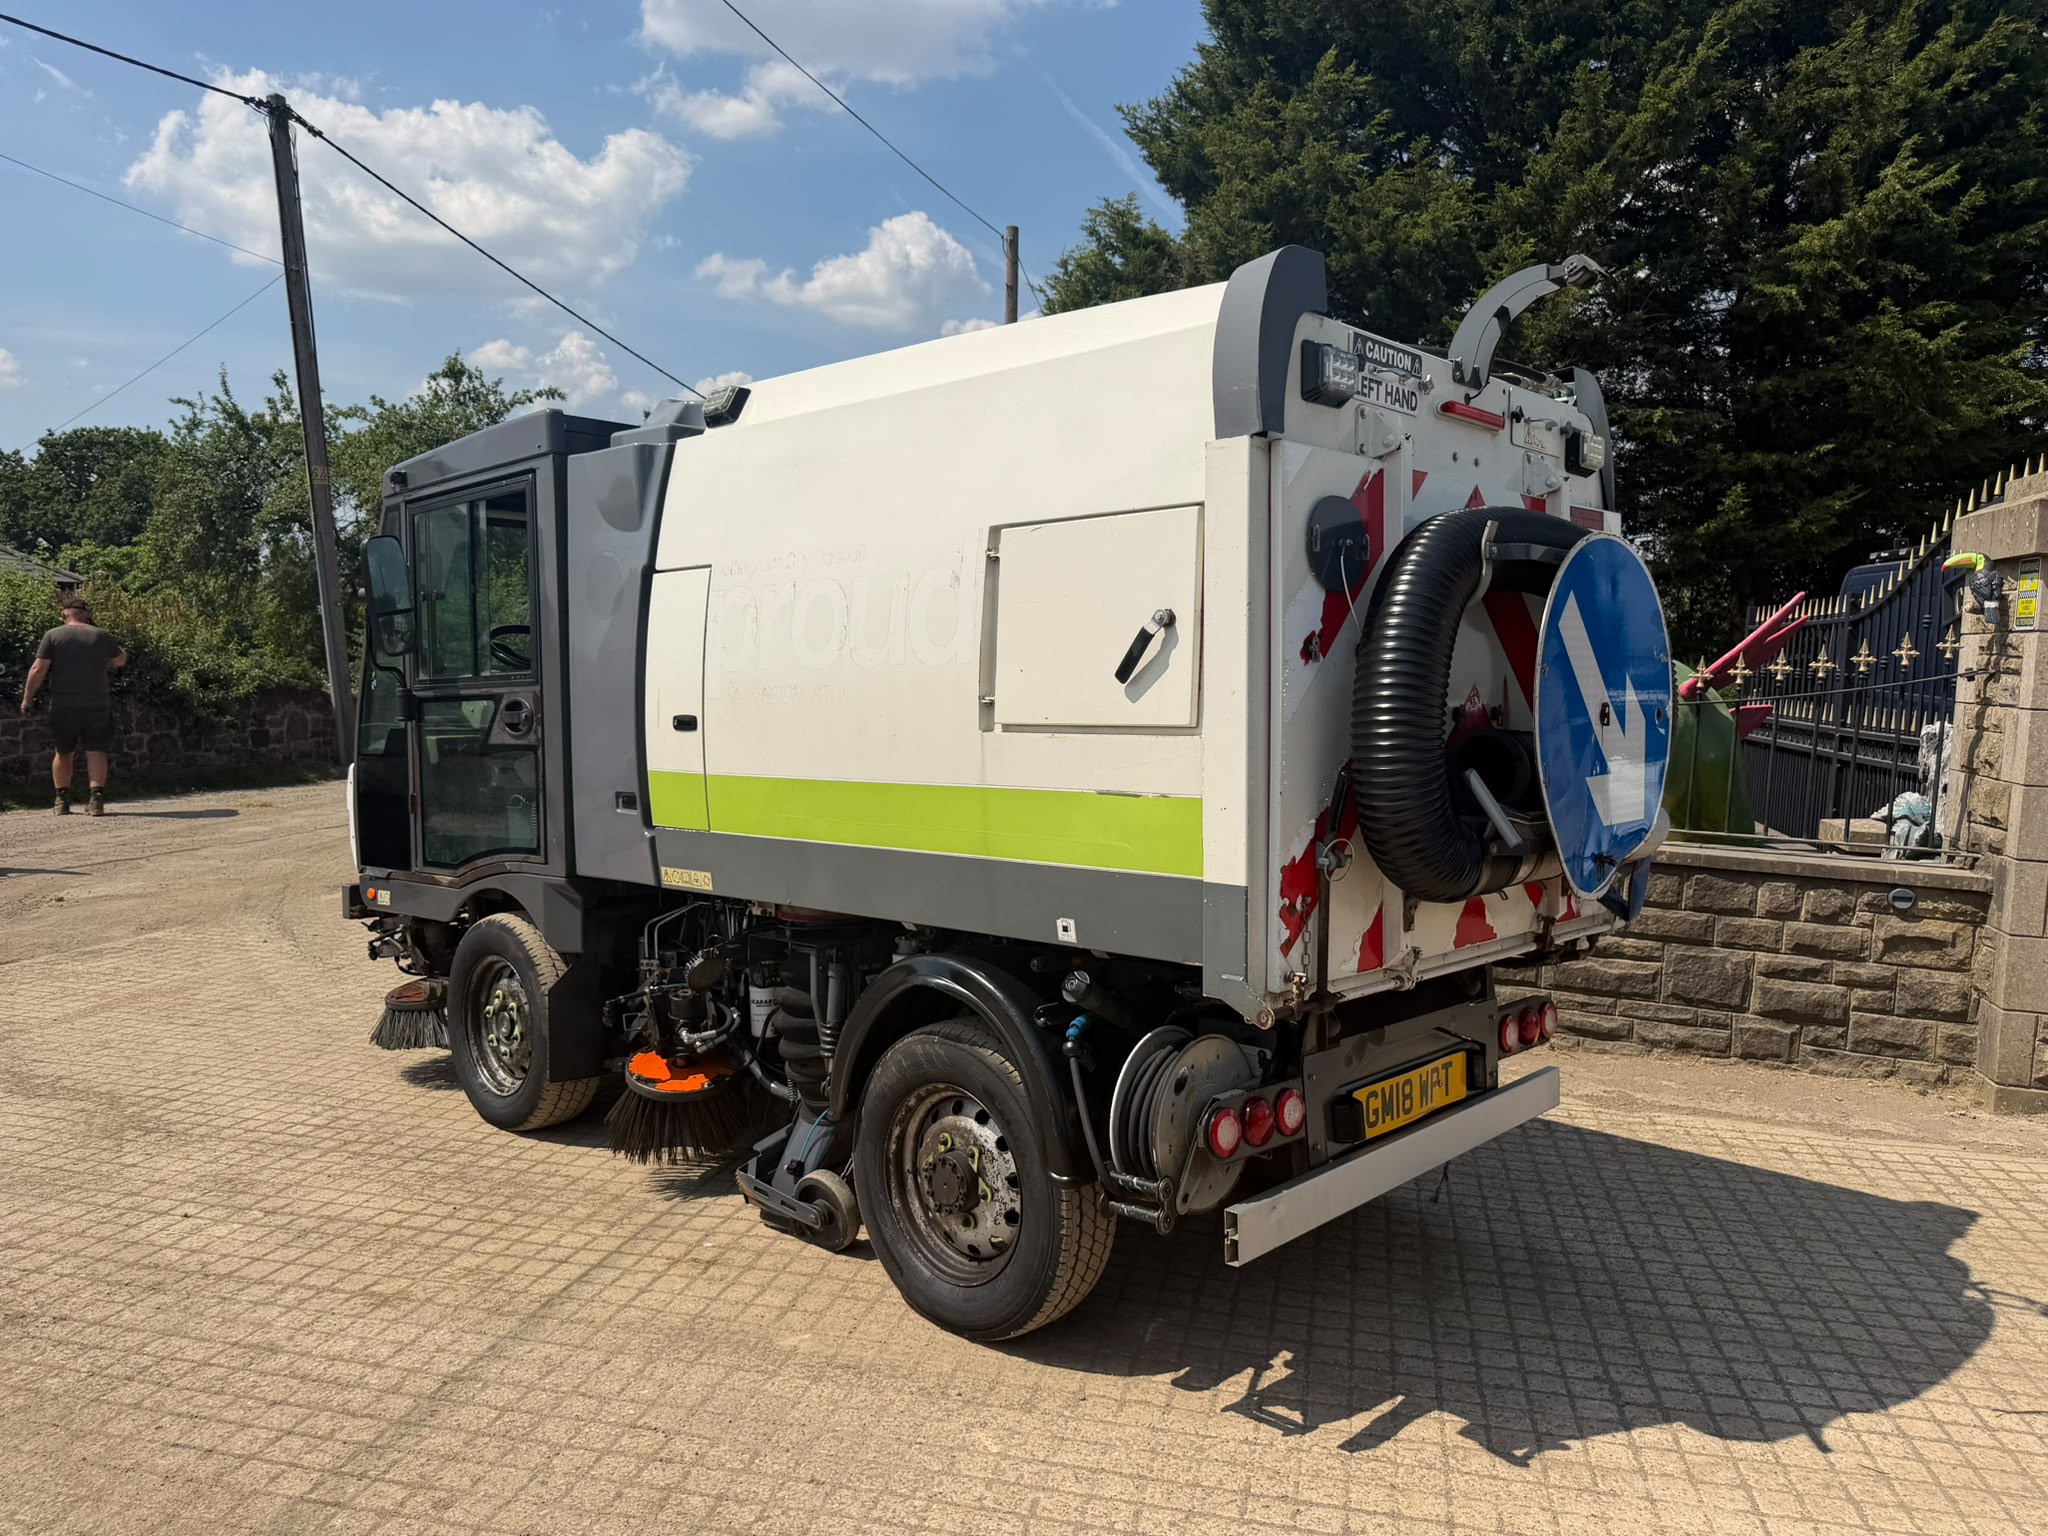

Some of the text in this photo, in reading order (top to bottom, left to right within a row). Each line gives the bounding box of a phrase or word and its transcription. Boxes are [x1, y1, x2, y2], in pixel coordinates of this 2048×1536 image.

[1365, 341, 1412, 371] CAUTION
[1355, 375, 1418, 412] EFT HAND
[1365, 1060, 1454, 1129] GM18 WPT
